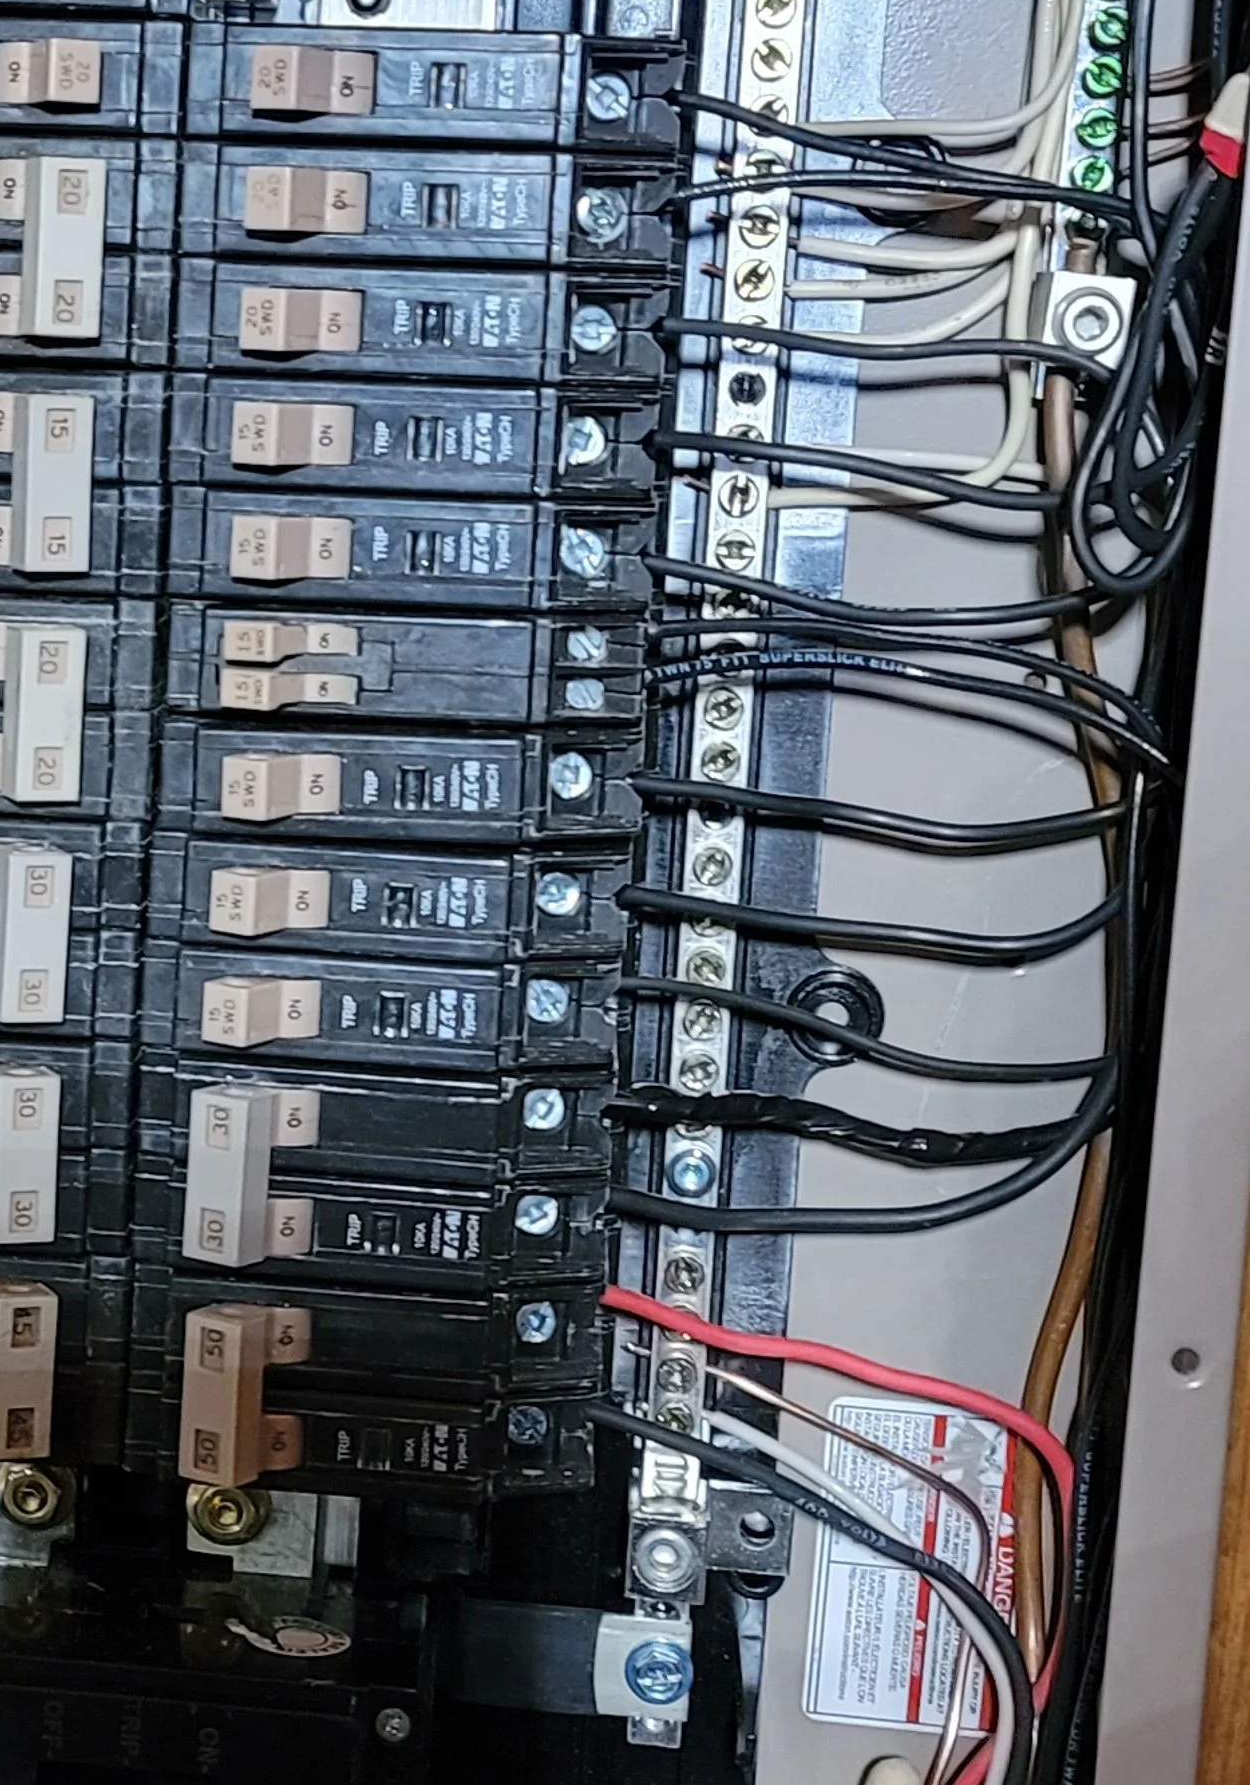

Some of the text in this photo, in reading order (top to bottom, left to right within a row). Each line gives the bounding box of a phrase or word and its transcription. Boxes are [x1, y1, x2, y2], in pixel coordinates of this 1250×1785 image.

[8, 61, 21, 83] ON
[273, 58, 287, 96] SWD
[409, 61, 425, 95] TRIP
[340, 76, 354, 97] ON
[3, 177, 16, 199] ON
[62, 175, 81, 205] 20
[402, 181, 417, 216] TRIP
[56, 293, 74, 323] 20
[260, 299, 274, 335] SWD
[395, 300, 410, 334] TRIP
[327, 312, 341, 333] ON
[51, 416, 69, 439] 15
[252, 414, 266, 451] SWD
[319, 425, 333, 447] ON
[374, 420, 390, 455] TRIP
[47, 534, 65, 556] 15
[252, 529, 266, 566] SWD
[319, 538, 333, 560] ON
[372, 526, 388, 561] TRIP
[236, 630, 249, 653] 15
[40, 645, 58, 673] 20
[758, 650, 865, 666] SUPERSLICK
[36, 757, 56, 785] 20
[310, 774, 324, 795] ON
[242, 770, 256, 808] SWD
[30, 869, 47, 895] 30
[229, 885, 243, 921] SWD
[296, 889, 310, 911] ON
[23, 980, 42, 1007] 30
[222, 999, 236, 1036] SWD
[288, 998, 302, 1020] ON
[19, 1092, 35, 1119] 30
[287, 1107, 301, 1128] ON
[212, 1108, 229, 1136] 30
[14, 1200, 33, 1227] 30
[207, 1220, 223, 1248] 30
[347, 1214, 362, 1245] TRIP
[205, 1329, 223, 1357] 50
[200, 1438, 217, 1465] 50
[337, 1430, 349, 1460] TRIP
